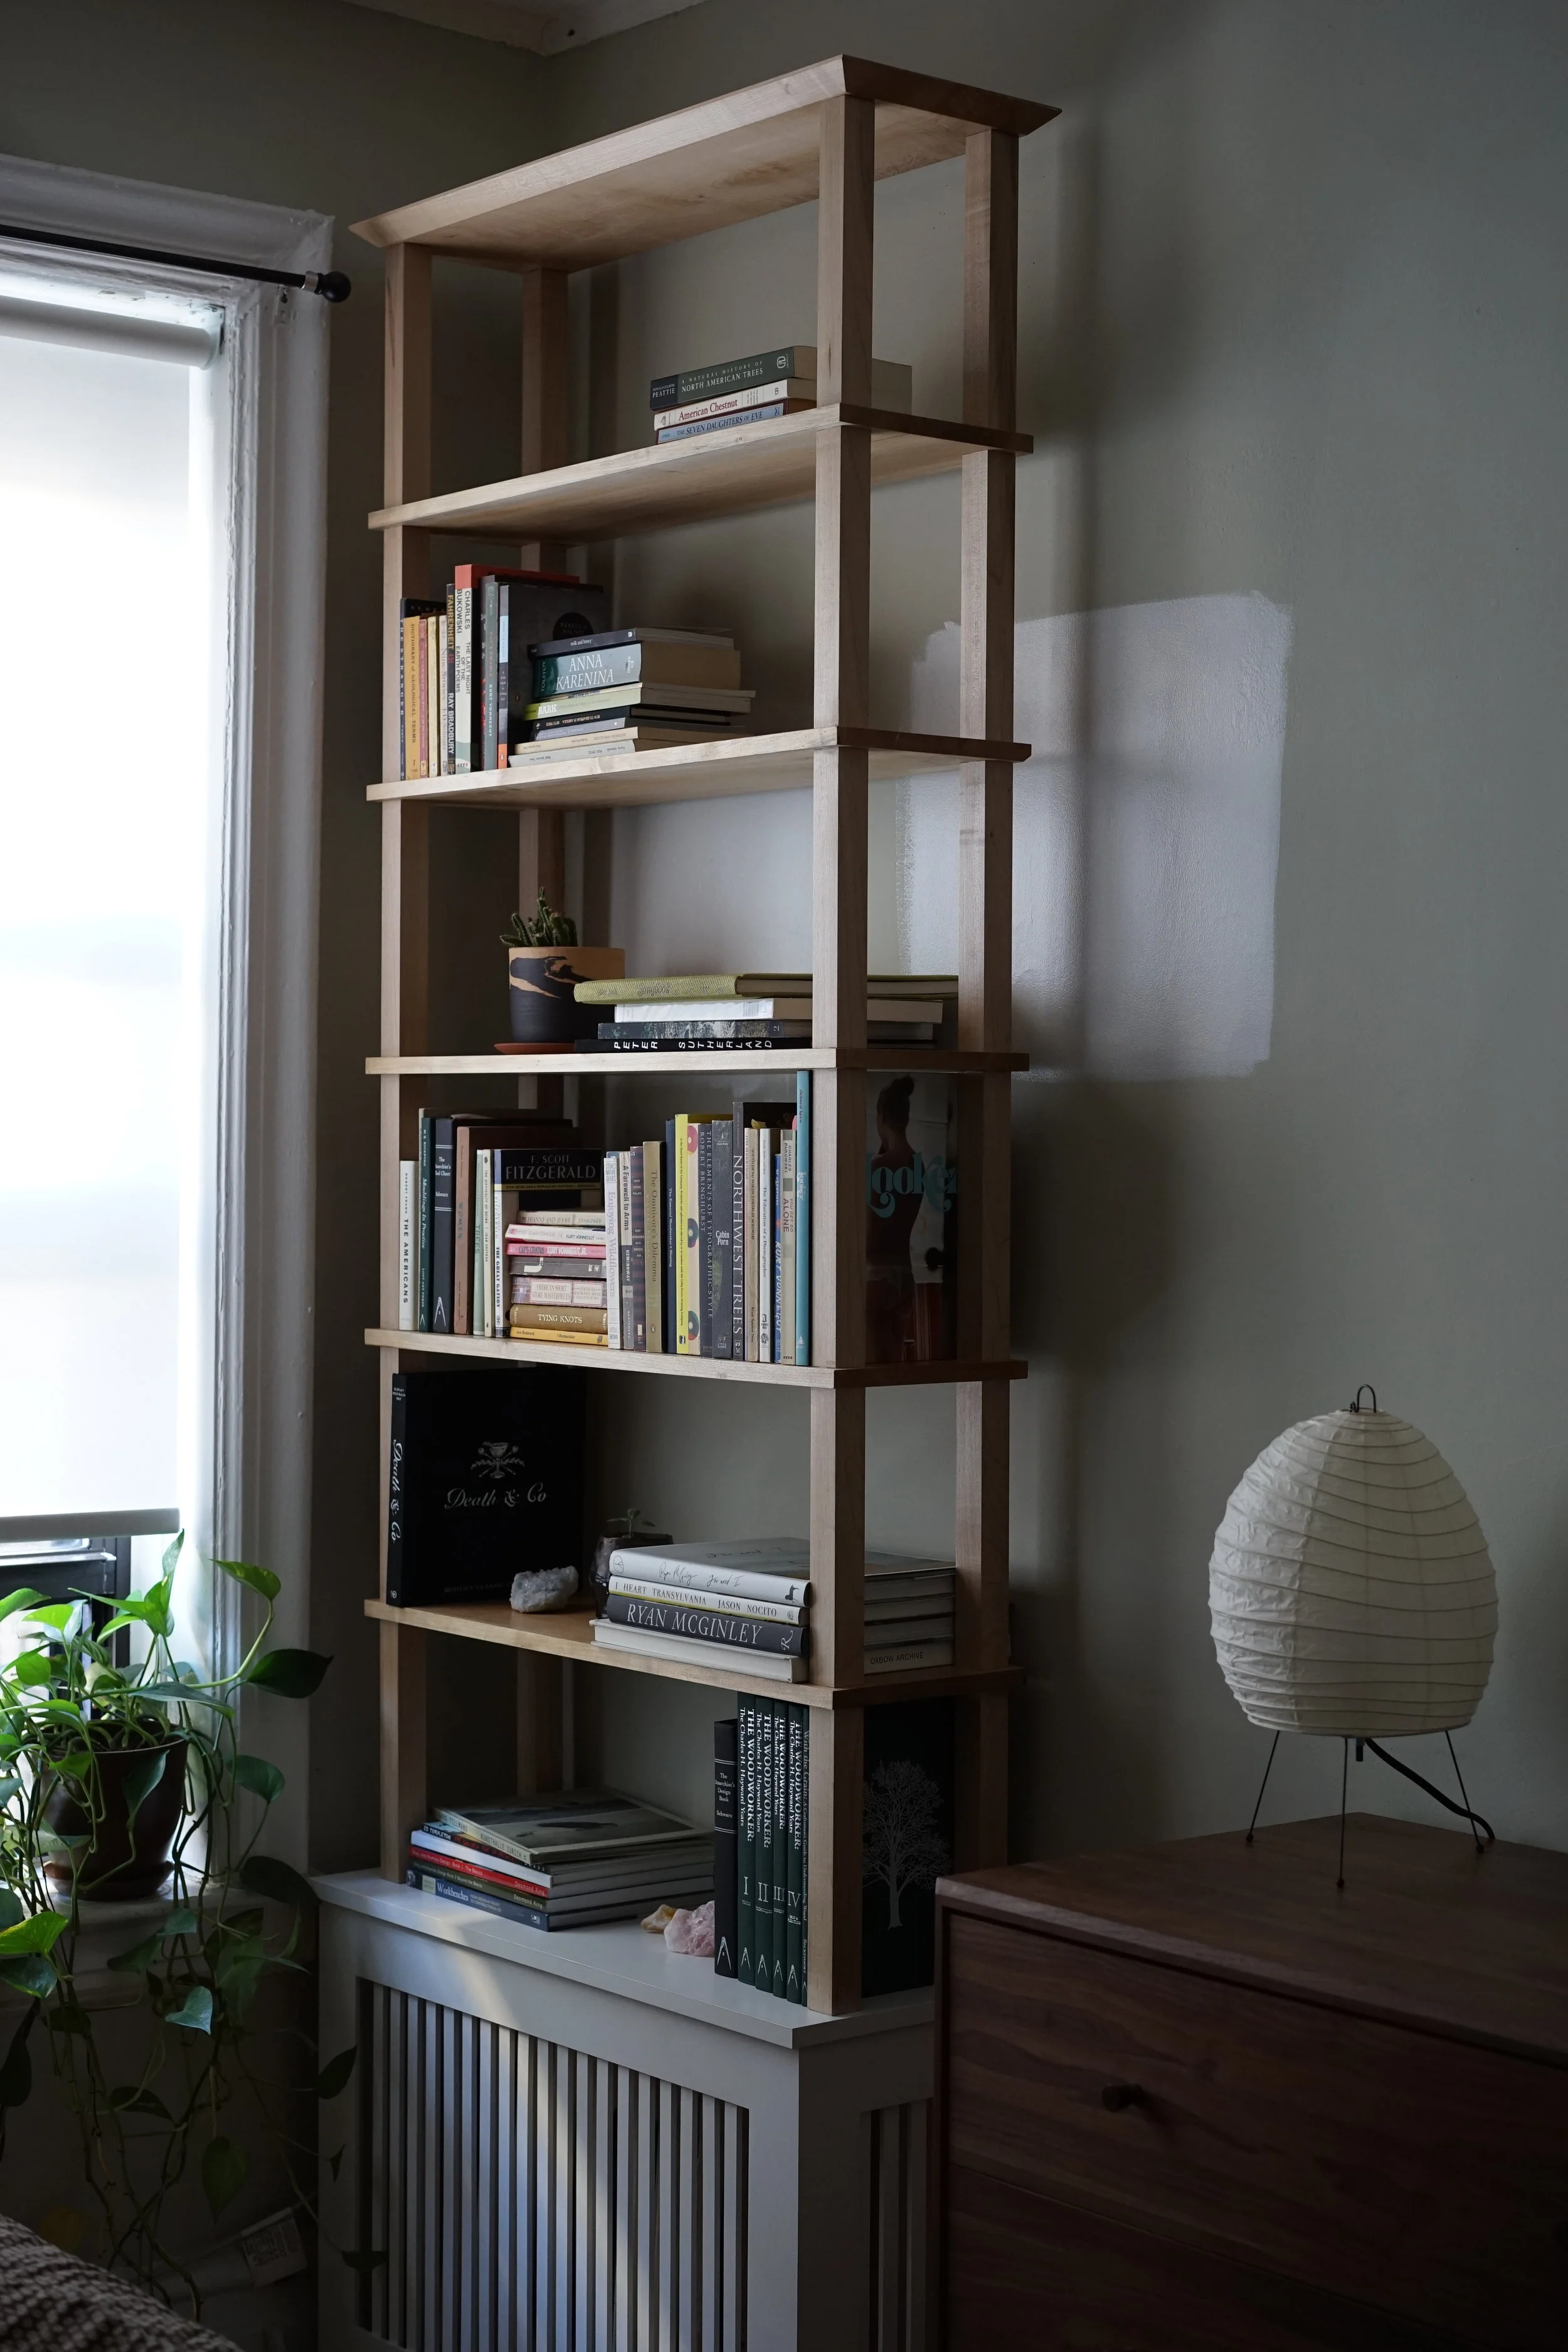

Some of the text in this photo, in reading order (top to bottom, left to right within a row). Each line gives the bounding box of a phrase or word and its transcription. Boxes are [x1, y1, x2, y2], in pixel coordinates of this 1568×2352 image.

[682, 368, 763, 393] NORTH AMERICAN TREES
[652, 388, 675, 399] PEATTIE
[679, 400, 738, 421] American Chestnut
[686, 411, 763, 435] SEVEN DAUGHTERS EVE
[461, 657, 465, 667] OF
[569, 654, 602, 672] ANNA
[556, 669, 614, 691] KARENINA
[538, 704, 558, 715] BARK
[637, 983, 670, 997] Songbook
[614, 1039, 773, 1049] PETER SUTHERLAND
[531, 1155, 569, 1164] F. SCOTT
[506, 1165, 596, 1180] FITZGERALD
[707, 1205, 712, 1216] OF
[716, 1230, 729, 1239] Cabin
[717, 1237, 729, 1246] Porn
[547, 1246, 558, 1254] KURT
[607, 1192, 618, 1297] Enjoying Wildflowers
[544, 1292, 570, 1301] MASTERPIECES
[538, 1314, 582, 1324] TYING KNOTS
[390, 1439, 403, 1544] Death & Co
[444, 1482, 548, 1510] Death & Co
[615, 1582, 776, 1617] I HEART TRANSYLVANIA JASON NOCITO
[627, 1603, 763, 1646] RYAN MCGINLEY
[870, 1651, 924, 1665] OXBOW ARCHIVE
[739, 1756, 745, 1766] H.
[756, 1761, 762, 1775] H.
[773, 1757, 779, 1766] H.
[789, 1767, 795, 1776] H.
[715, 1779, 736, 1788] Anarchist's
[763, 1714, 771, 1848] THE WOODWORKER:
[718, 1788, 731, 1796] Design
[716, 1810, 733, 1818] Schwarz
[514, 1880, 544, 1897] Desmond King
[743, 1876, 749, 1895] I
[758, 1882, 769, 1903] II
[773, 1886, 786, 1902] III
[788, 1890, 802, 1908] IV
[513, 1894, 543, 1909] Desmond King
